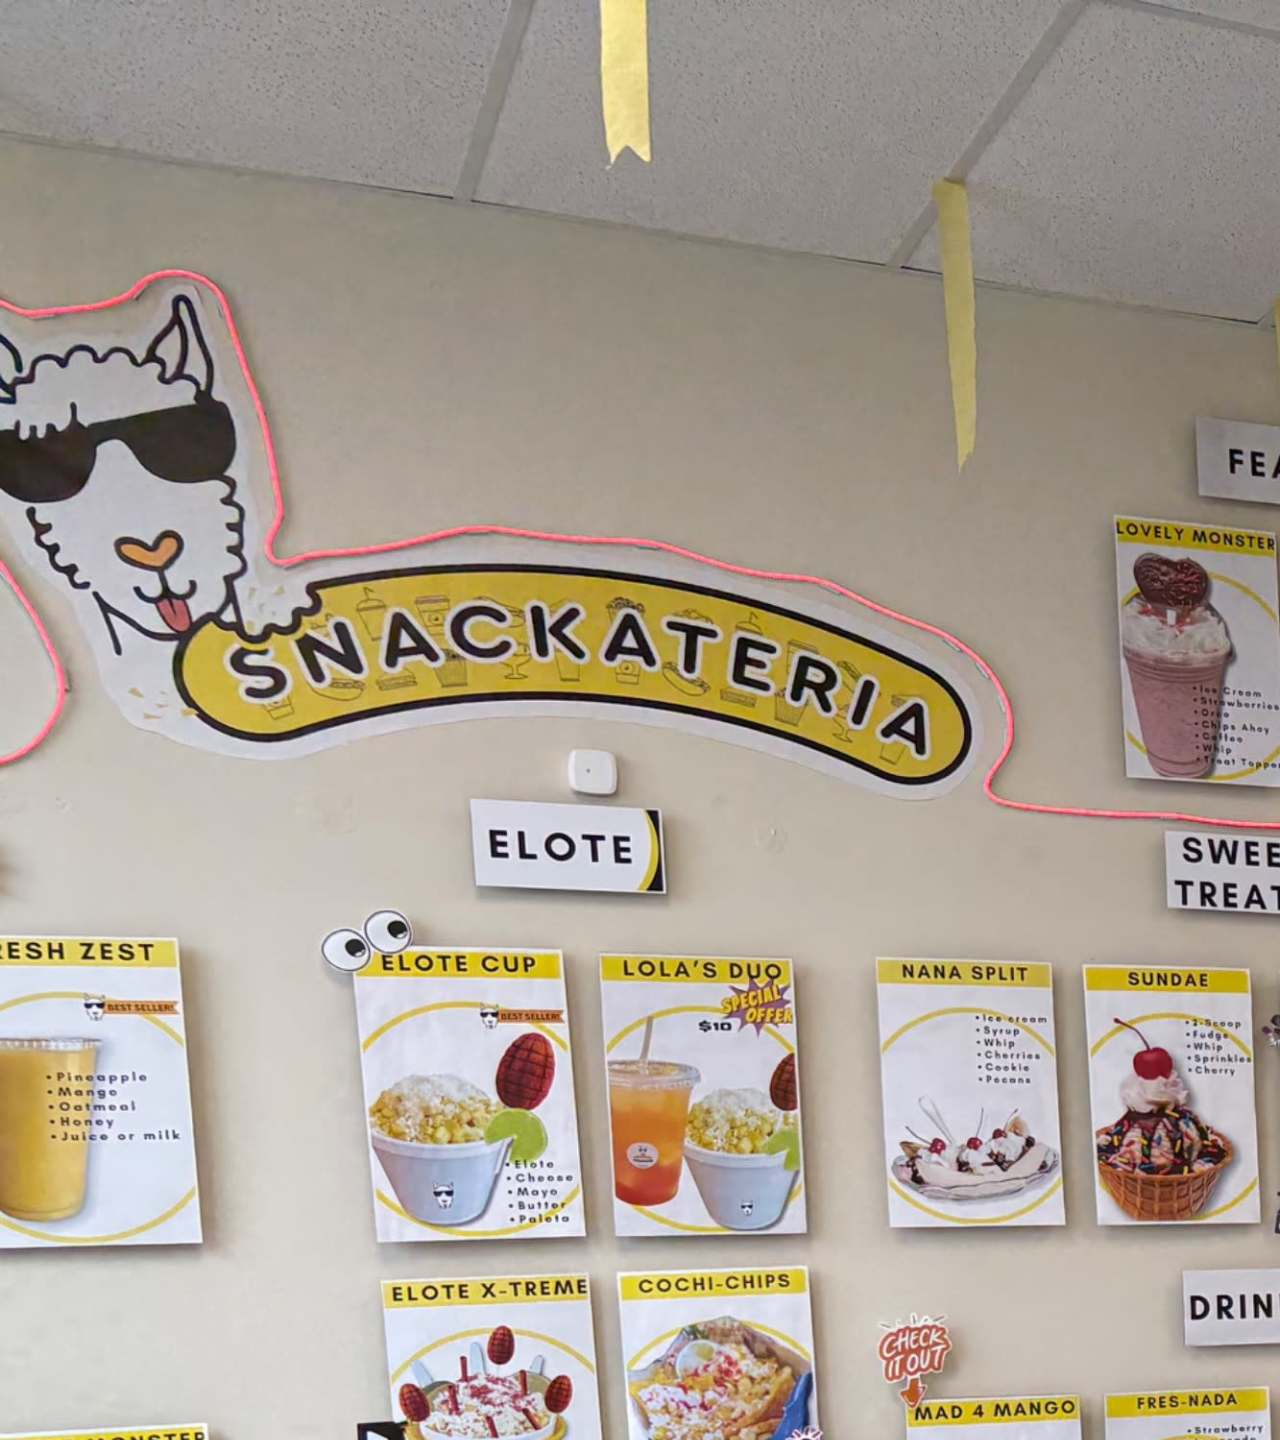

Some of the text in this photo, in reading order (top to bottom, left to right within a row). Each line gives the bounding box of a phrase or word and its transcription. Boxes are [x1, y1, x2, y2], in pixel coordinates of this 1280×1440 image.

[1116, 521, 1276, 552] LOVELY MONSTER
[229, 604, 931, 755] SNACKATERIA
[488, 828, 634, 866] ELOTE
[80, 943, 154, 961] ZEST
[382, 954, 536, 973] ELOTE CUP
[623, 960, 782, 980] LOLA'S DUO
[902, 964, 1028, 982] NANA SPLIT
[1128, 972, 1209, 988] SUNDAE
[722, 984, 781, 1017] SPECIAL
[746, 1006, 794, 1024] OFFER
[985, 1038, 1015, 1049] Whip
[57, 1072, 147, 1084] Pineapple
[58, 1088, 117, 1098] Mango
[60, 1102, 136, 1111] Oatmeal
[61, 1117, 114, 1128] Honey
[62, 1130, 180, 1141] Juice or milk
[517, 1187, 557, 1198] Mayo
[392, 1278, 588, 1302] ELOTE X-TREME
[638, 1273, 791, 1293] COCHI-CHIPS
[881, 1326, 945, 1357] CHECK
[887, 1347, 945, 1379] IT OUT
[914, 1400, 1075, 1421] MAD 4 MANGO
[1137, 1393, 1237, 1410] FRES-NADA
